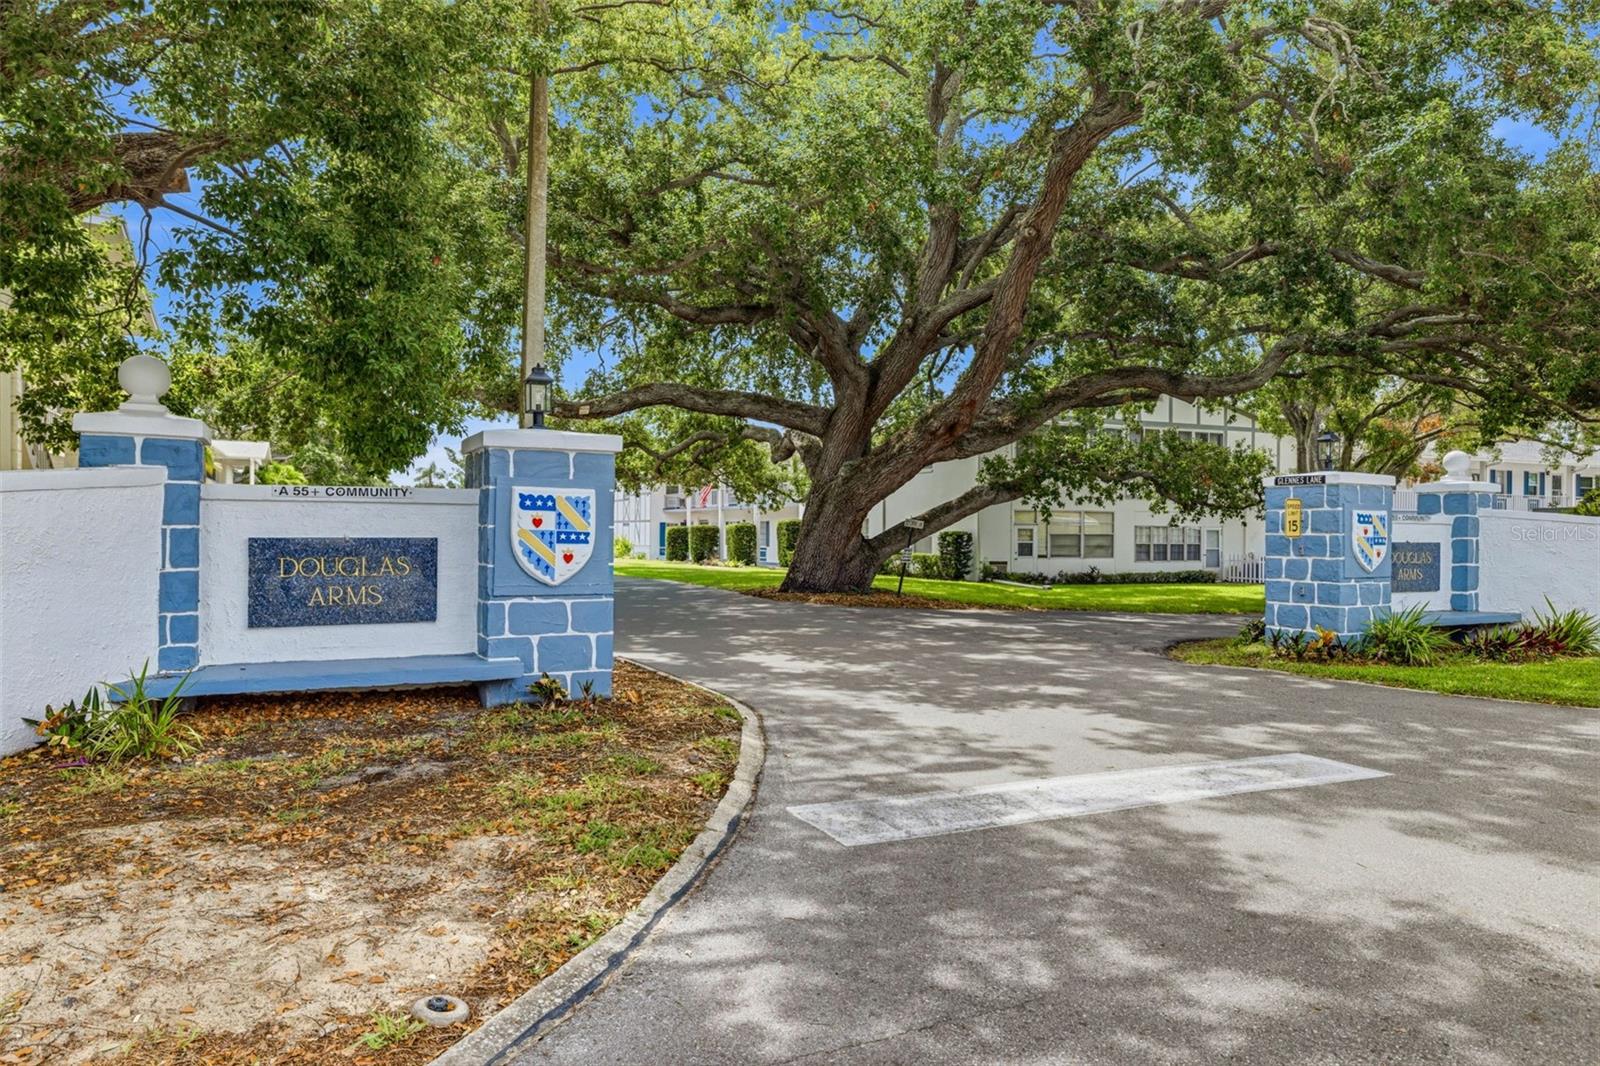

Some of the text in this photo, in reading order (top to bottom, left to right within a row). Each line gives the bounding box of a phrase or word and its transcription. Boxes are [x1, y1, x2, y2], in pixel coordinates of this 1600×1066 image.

[1306, 475, 1322, 484] LANE
[279, 486, 408, 497] A 55+ COMMUNITY
[1288, 520, 1299, 532] 15
[278, 556, 412, 578] DOUGLAS
[1398, 568, 1423, 581] ARMS
[308, 585, 383, 607] ARMS
